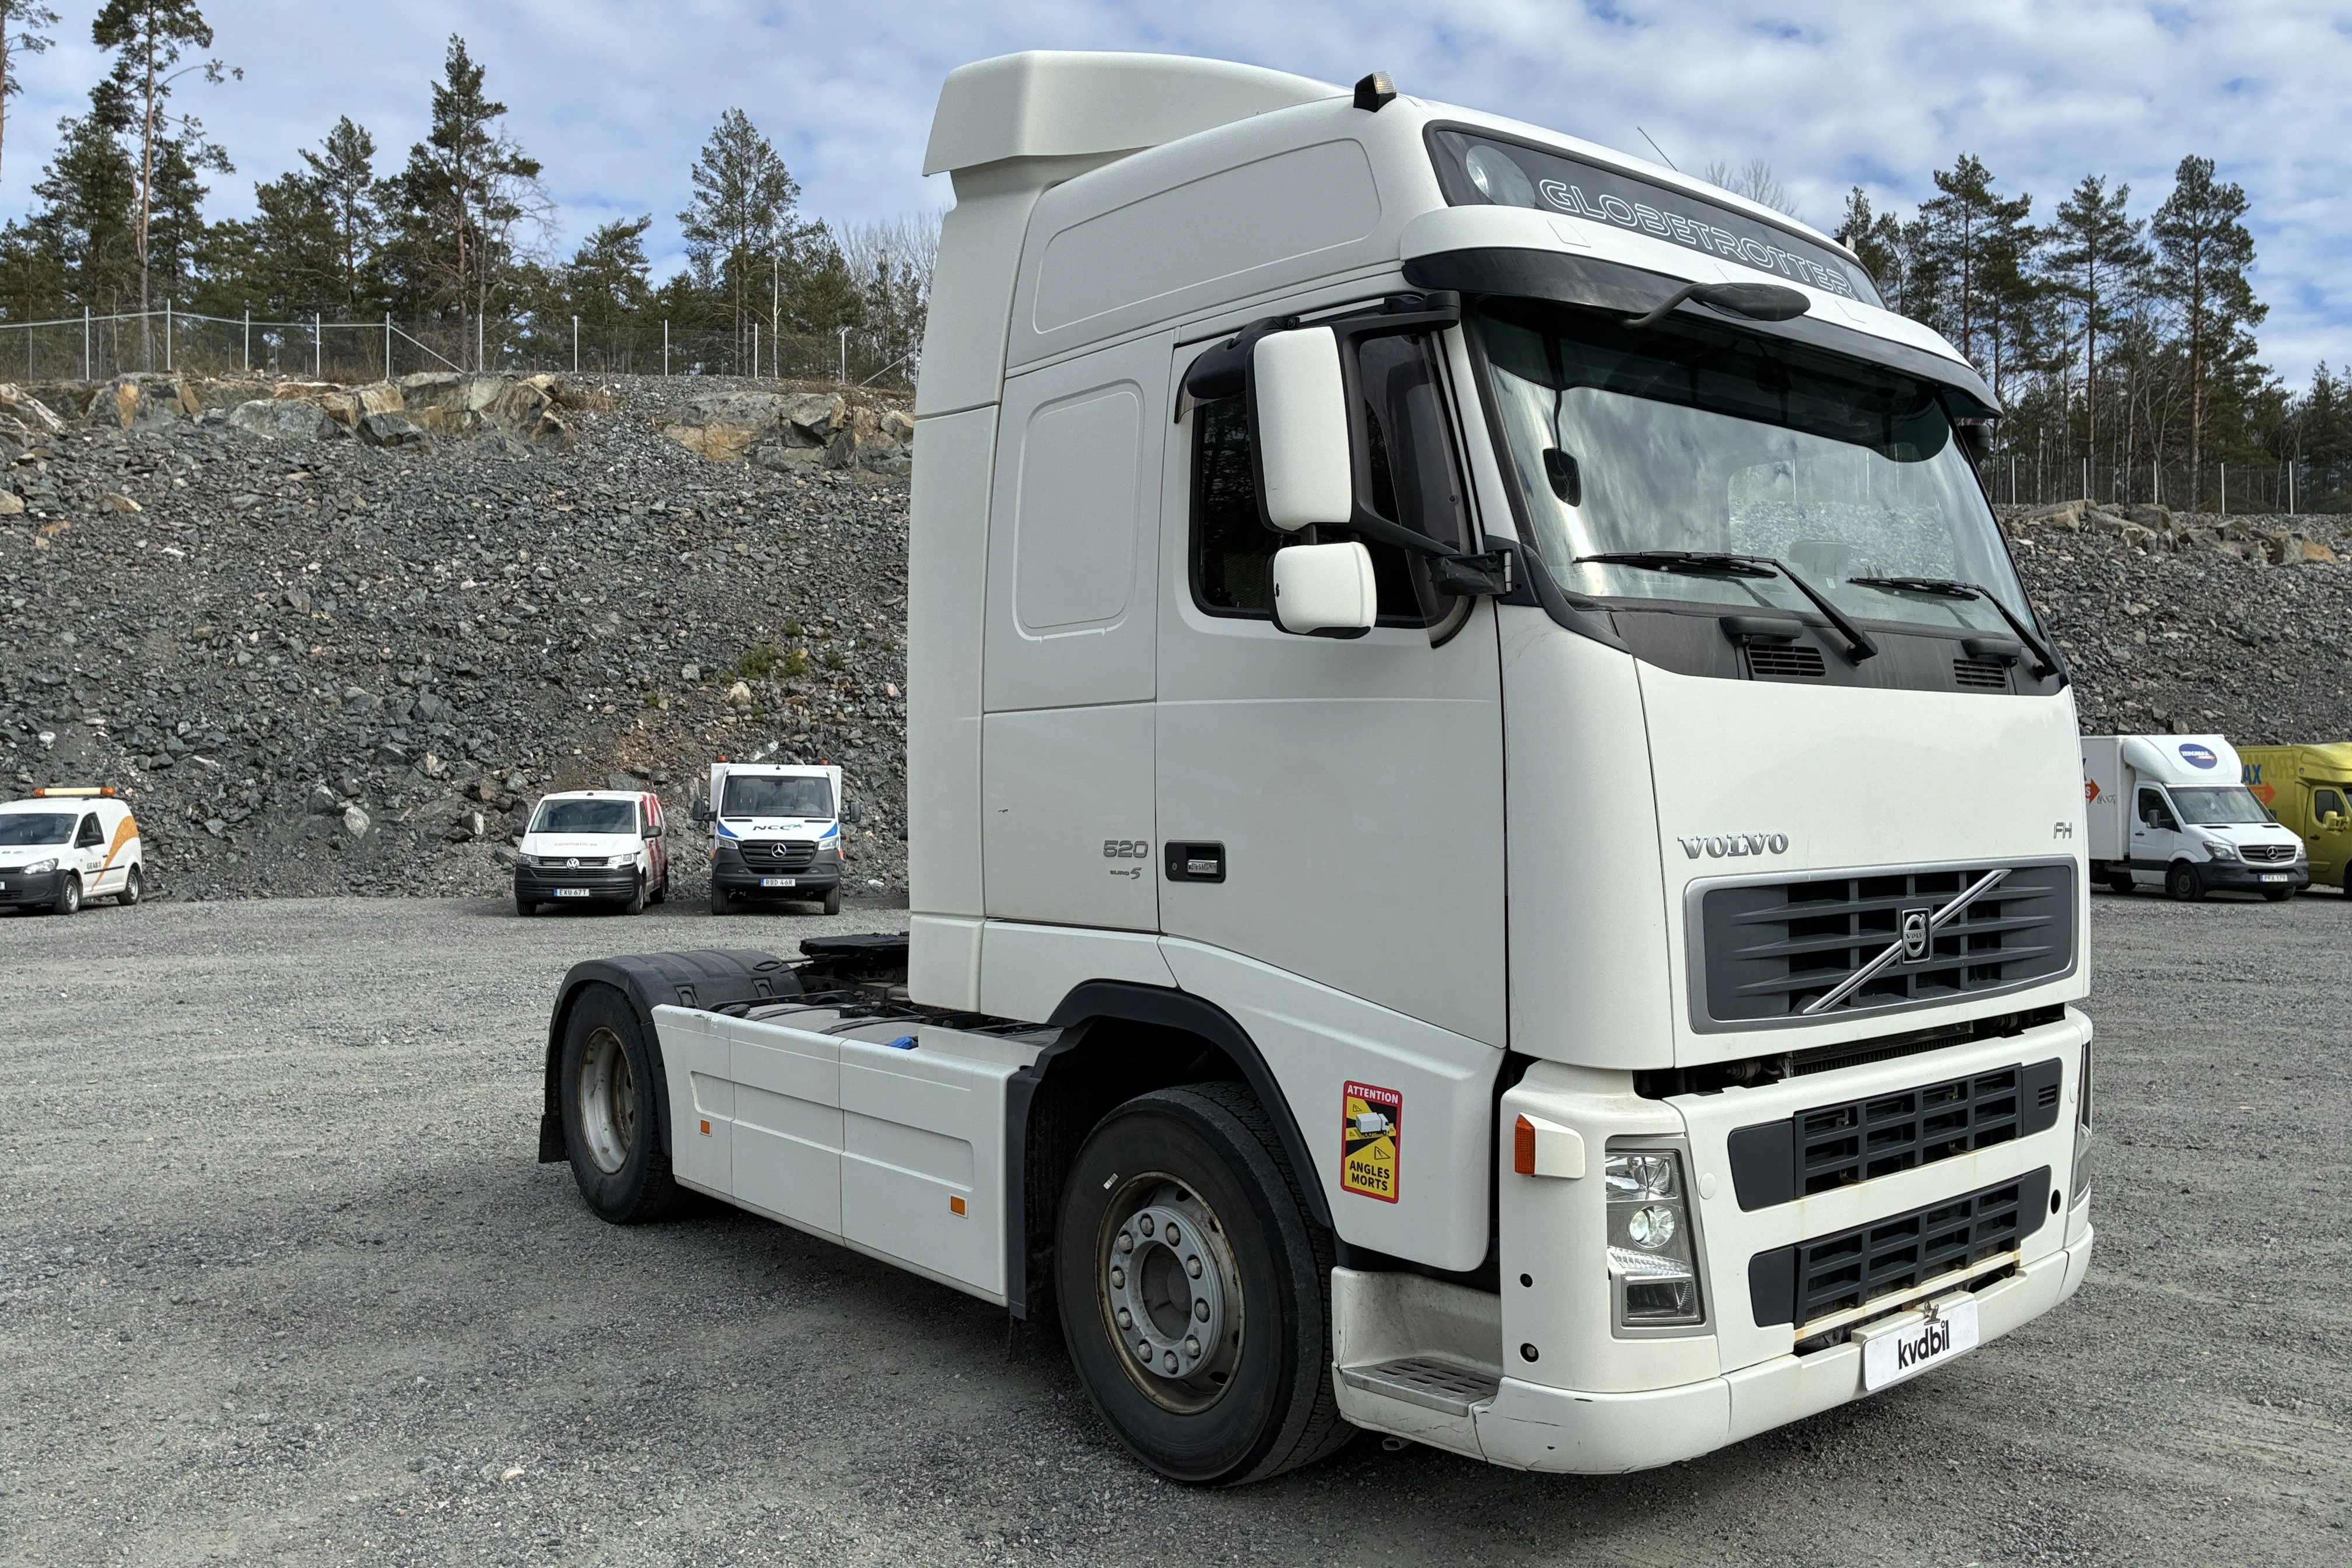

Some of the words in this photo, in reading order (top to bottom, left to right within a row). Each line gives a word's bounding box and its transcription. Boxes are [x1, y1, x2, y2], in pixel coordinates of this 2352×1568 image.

[1539, 178, 1859, 300] GLOBETROTTER
[2053, 821, 2073, 839] FH
[1103, 840, 1149, 858] 520
[1677, 831, 1789, 859] VOLVO
[1347, 1084, 1398, 1104] ATTENTION
[1349, 1160, 1390, 1180] ANGLES
[1351, 1172, 1388, 1191] MORTS
[1898, 1319, 1950, 1370] kvdbil
